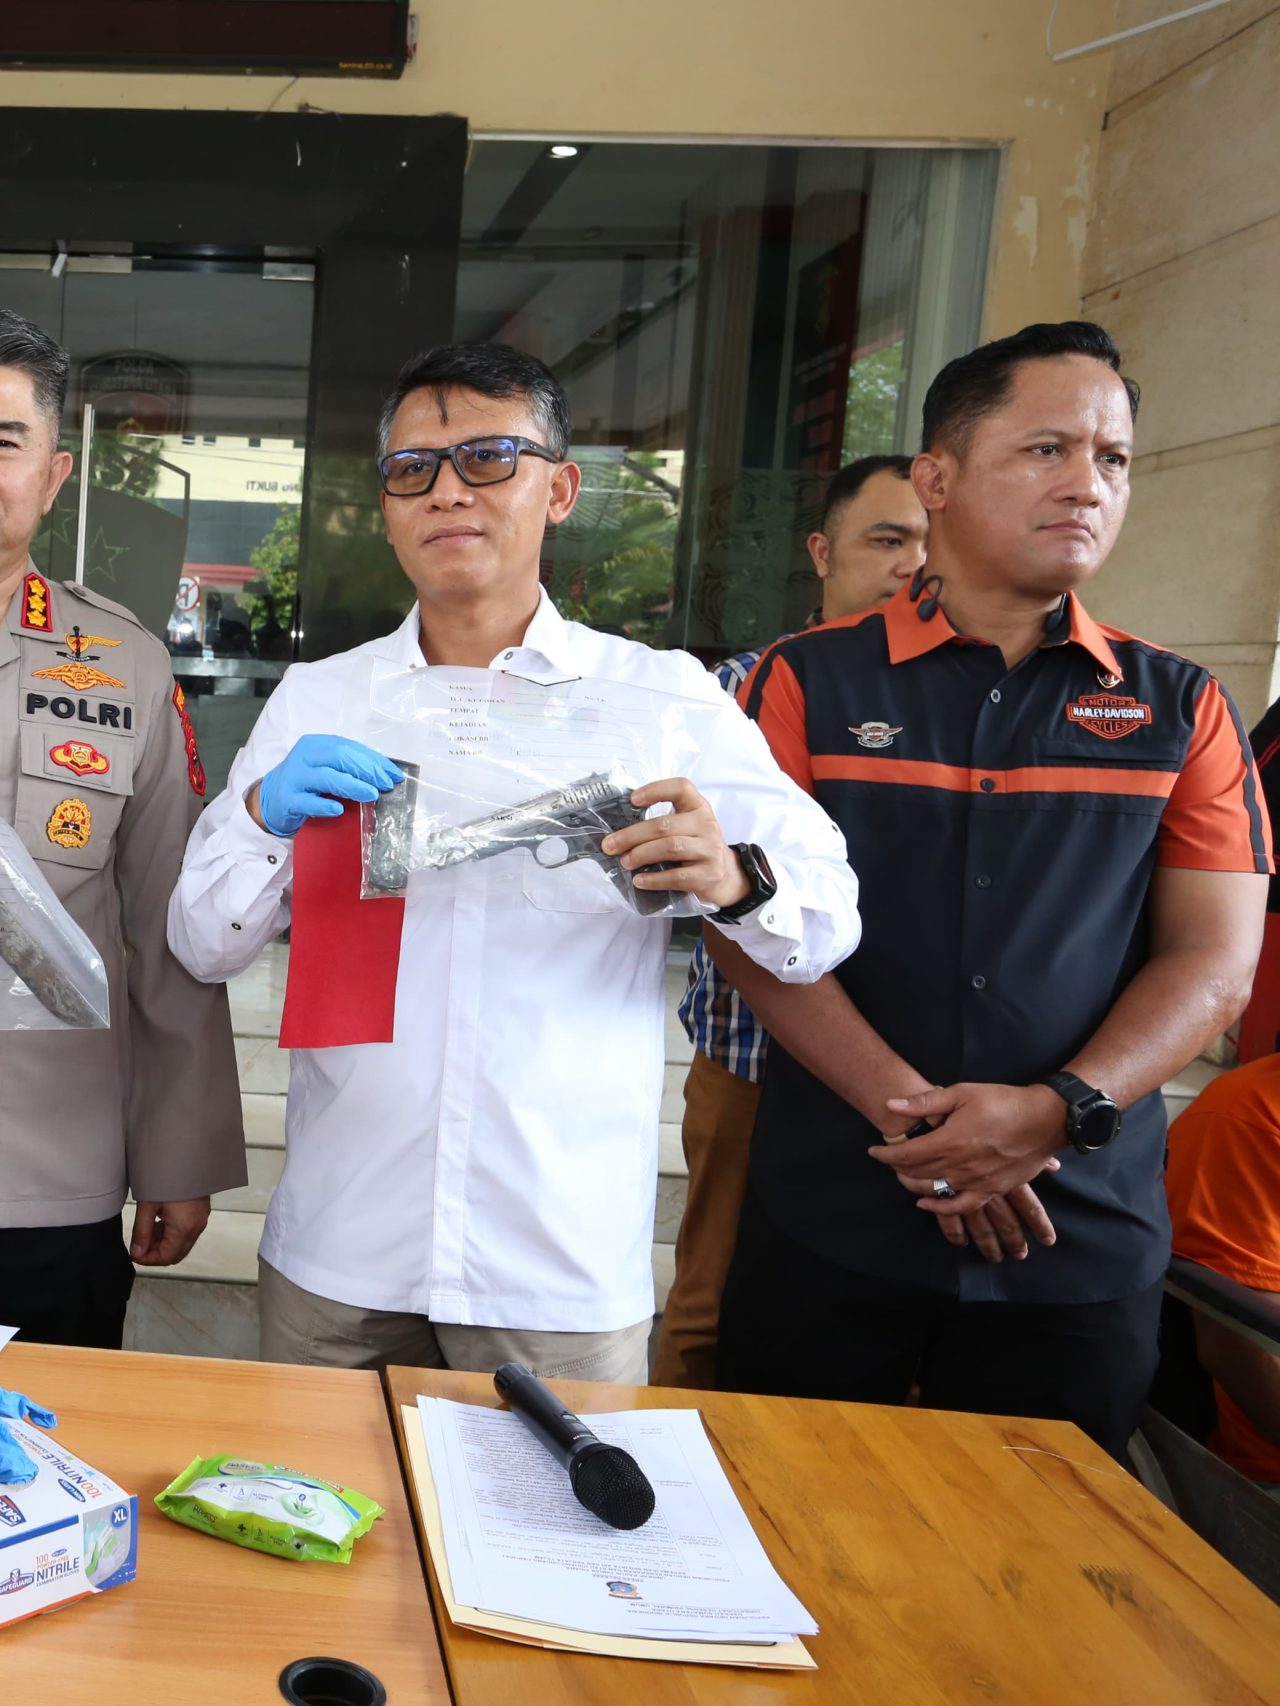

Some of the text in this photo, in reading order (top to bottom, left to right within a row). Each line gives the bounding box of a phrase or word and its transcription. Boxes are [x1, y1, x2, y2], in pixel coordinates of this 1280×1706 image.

[26, 692, 132, 730] POLRI
[1073, 707, 1145, 719] HARLEY-DAVIDSON
[41, 1453, 83, 1485] NITRILE
[113, 1509, 127, 1523] XL
[36, 1556, 80, 1582] NITRILE
